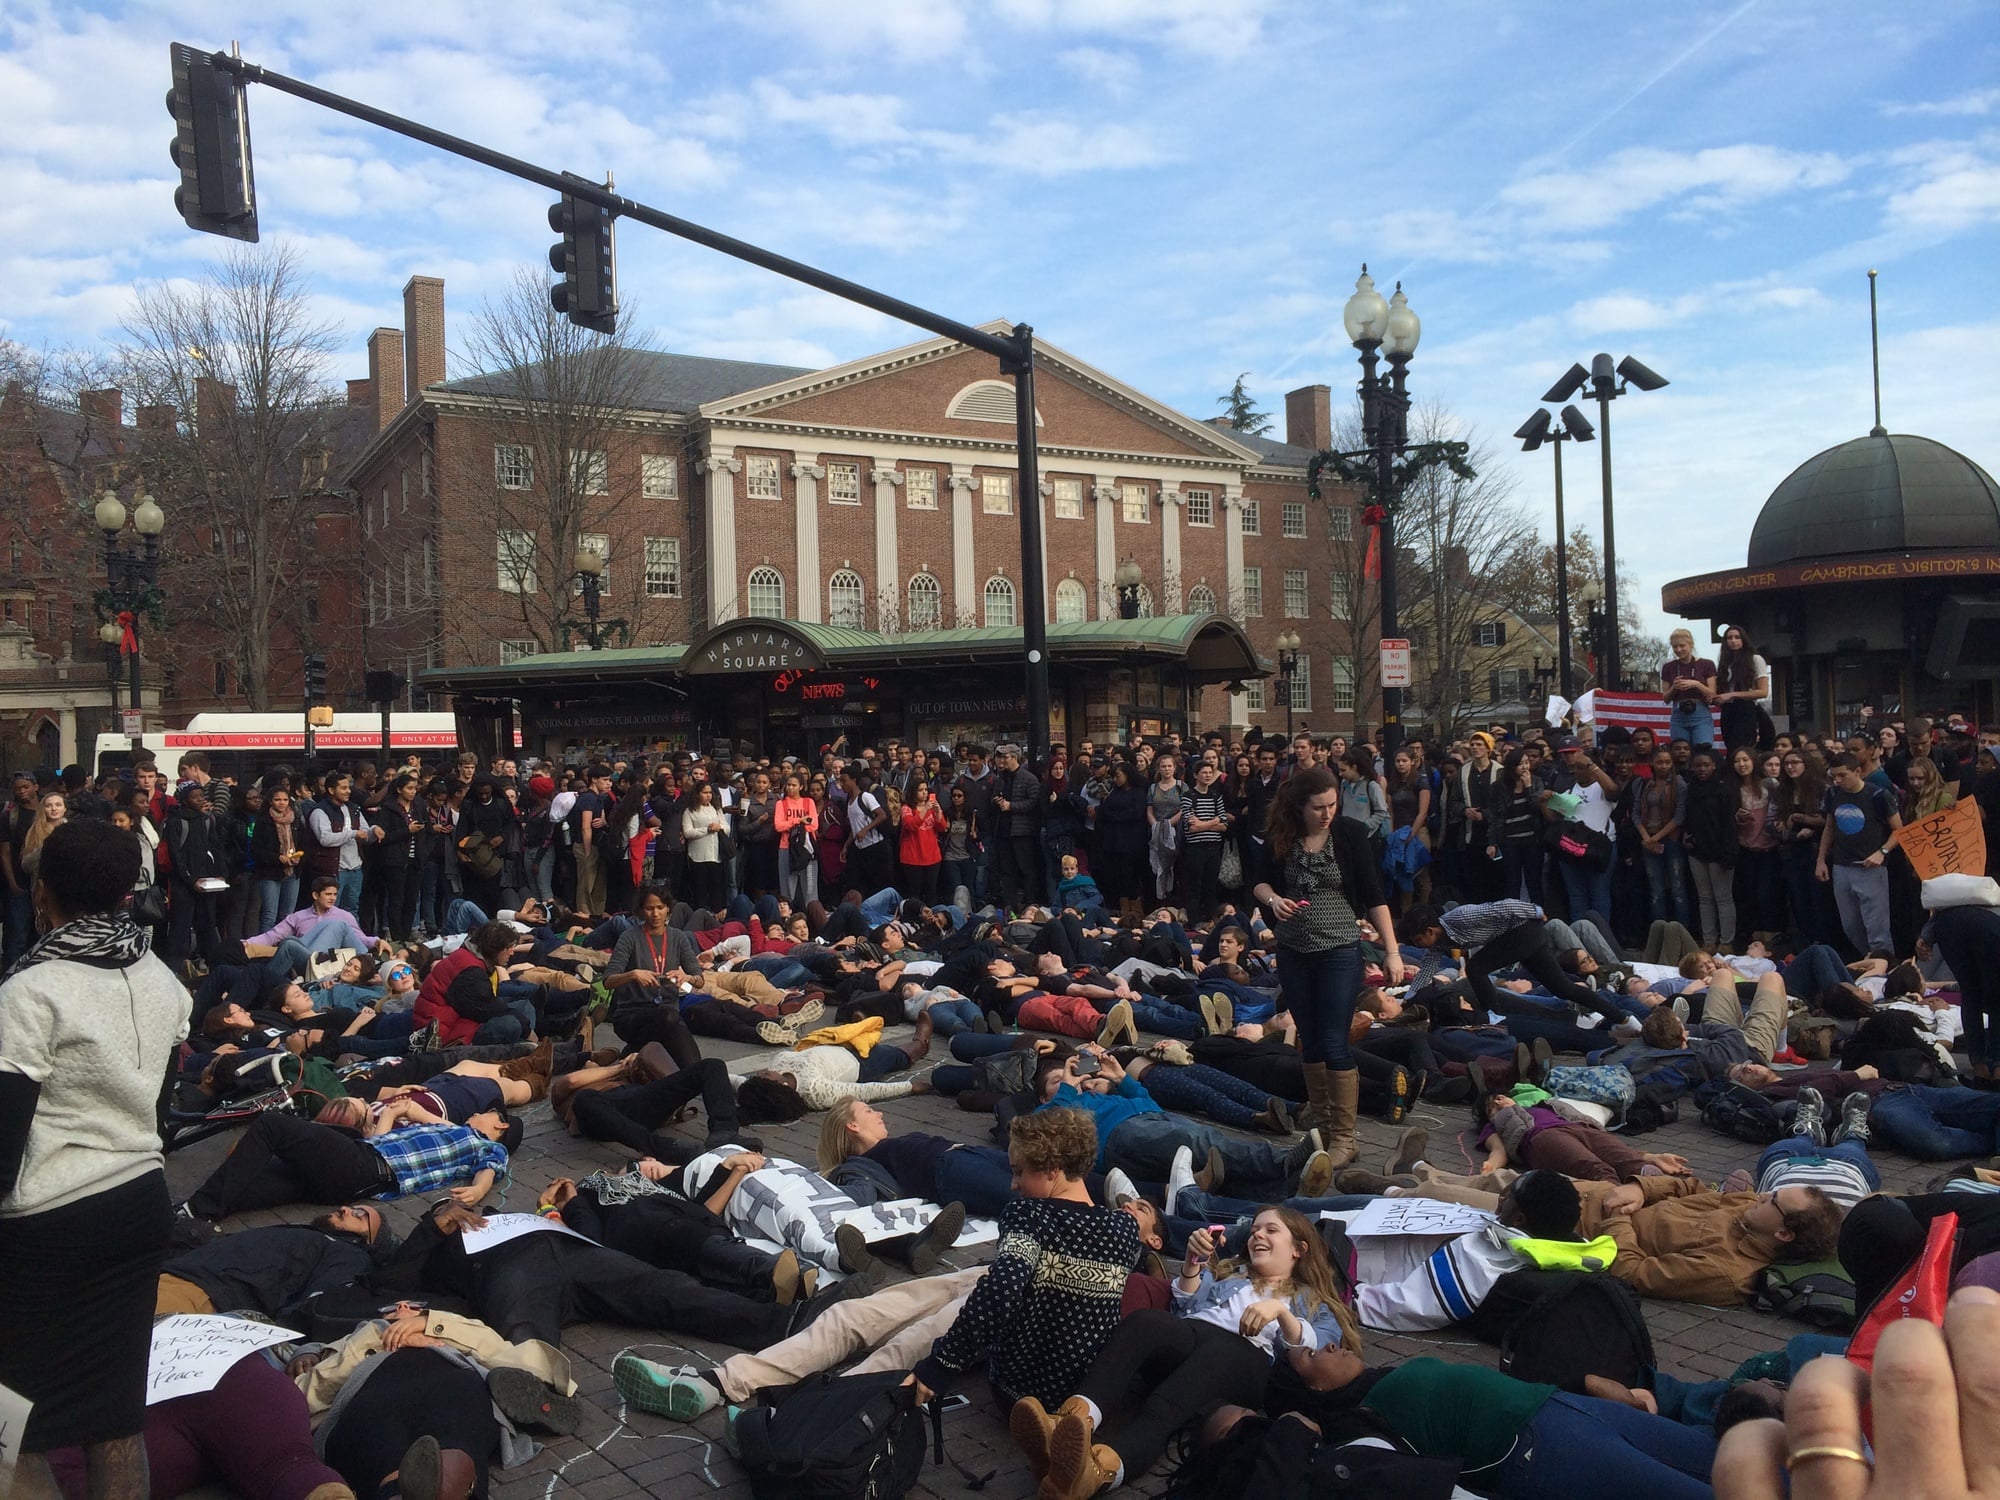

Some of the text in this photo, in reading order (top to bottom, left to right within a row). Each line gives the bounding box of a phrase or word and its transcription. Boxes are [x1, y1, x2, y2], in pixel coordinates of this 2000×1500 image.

[1800, 562, 1897, 582] CAMBRIDGE
[1725, 573, 1777, 590] CENTER
[708, 632, 804, 662] HARVARD
[723, 655, 788, 668] SQUARE
[802, 682, 845, 699] NEWS
[910, 703, 931, 714] OUT
[933, 702, 945, 713] OF
[949, 700, 980, 712] TOWN
[983, 699, 1013, 711] NEWS
[536, 718, 573, 730] NATIONAL
[581, 716, 614, 728] FOREIGN
[615, 713, 671, 726] PUBLICATIONS
[175, 735, 229, 747] GOYA
[1898, 826, 1932, 858] HAS
[171, 1318, 289, 1338] HARVARD
[150, 1365, 204, 1389] Peace
